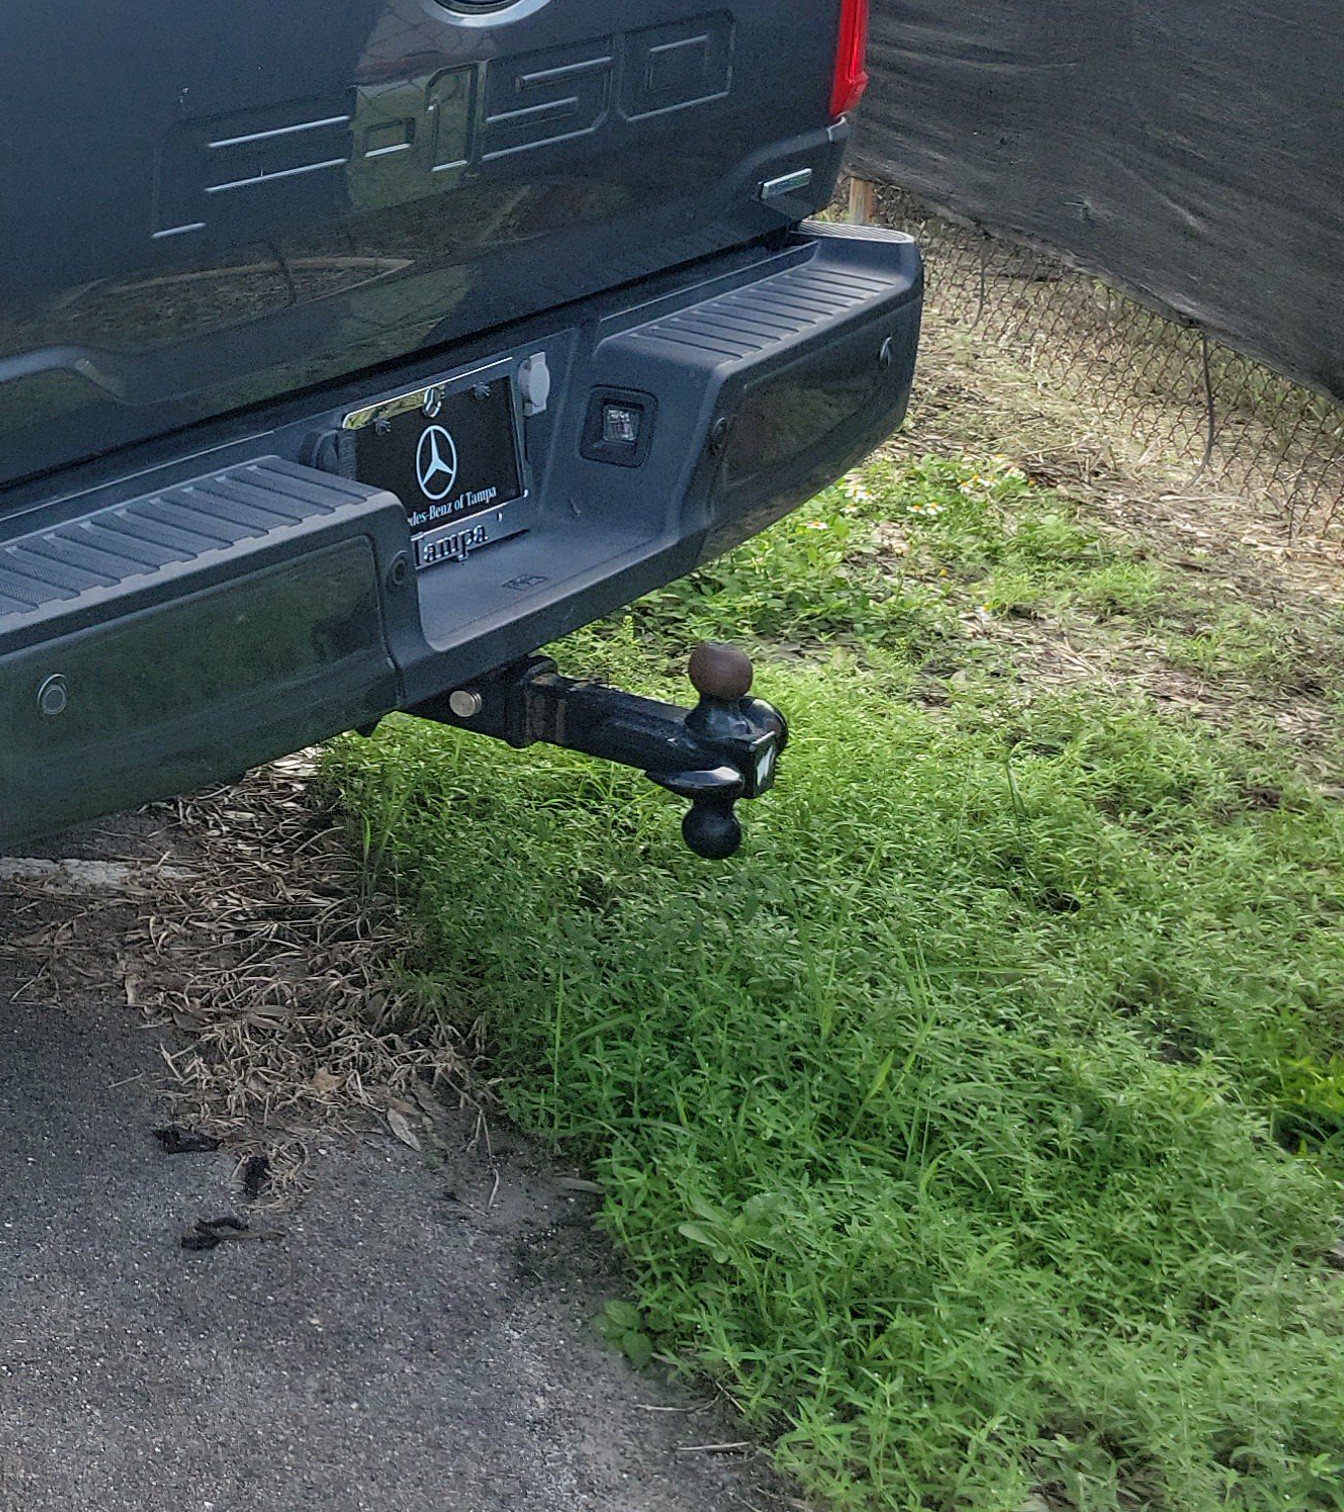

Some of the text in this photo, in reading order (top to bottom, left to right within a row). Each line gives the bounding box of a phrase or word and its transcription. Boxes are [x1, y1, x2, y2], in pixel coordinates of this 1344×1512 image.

[407, 486, 497, 527] des-Benz of Tampa
